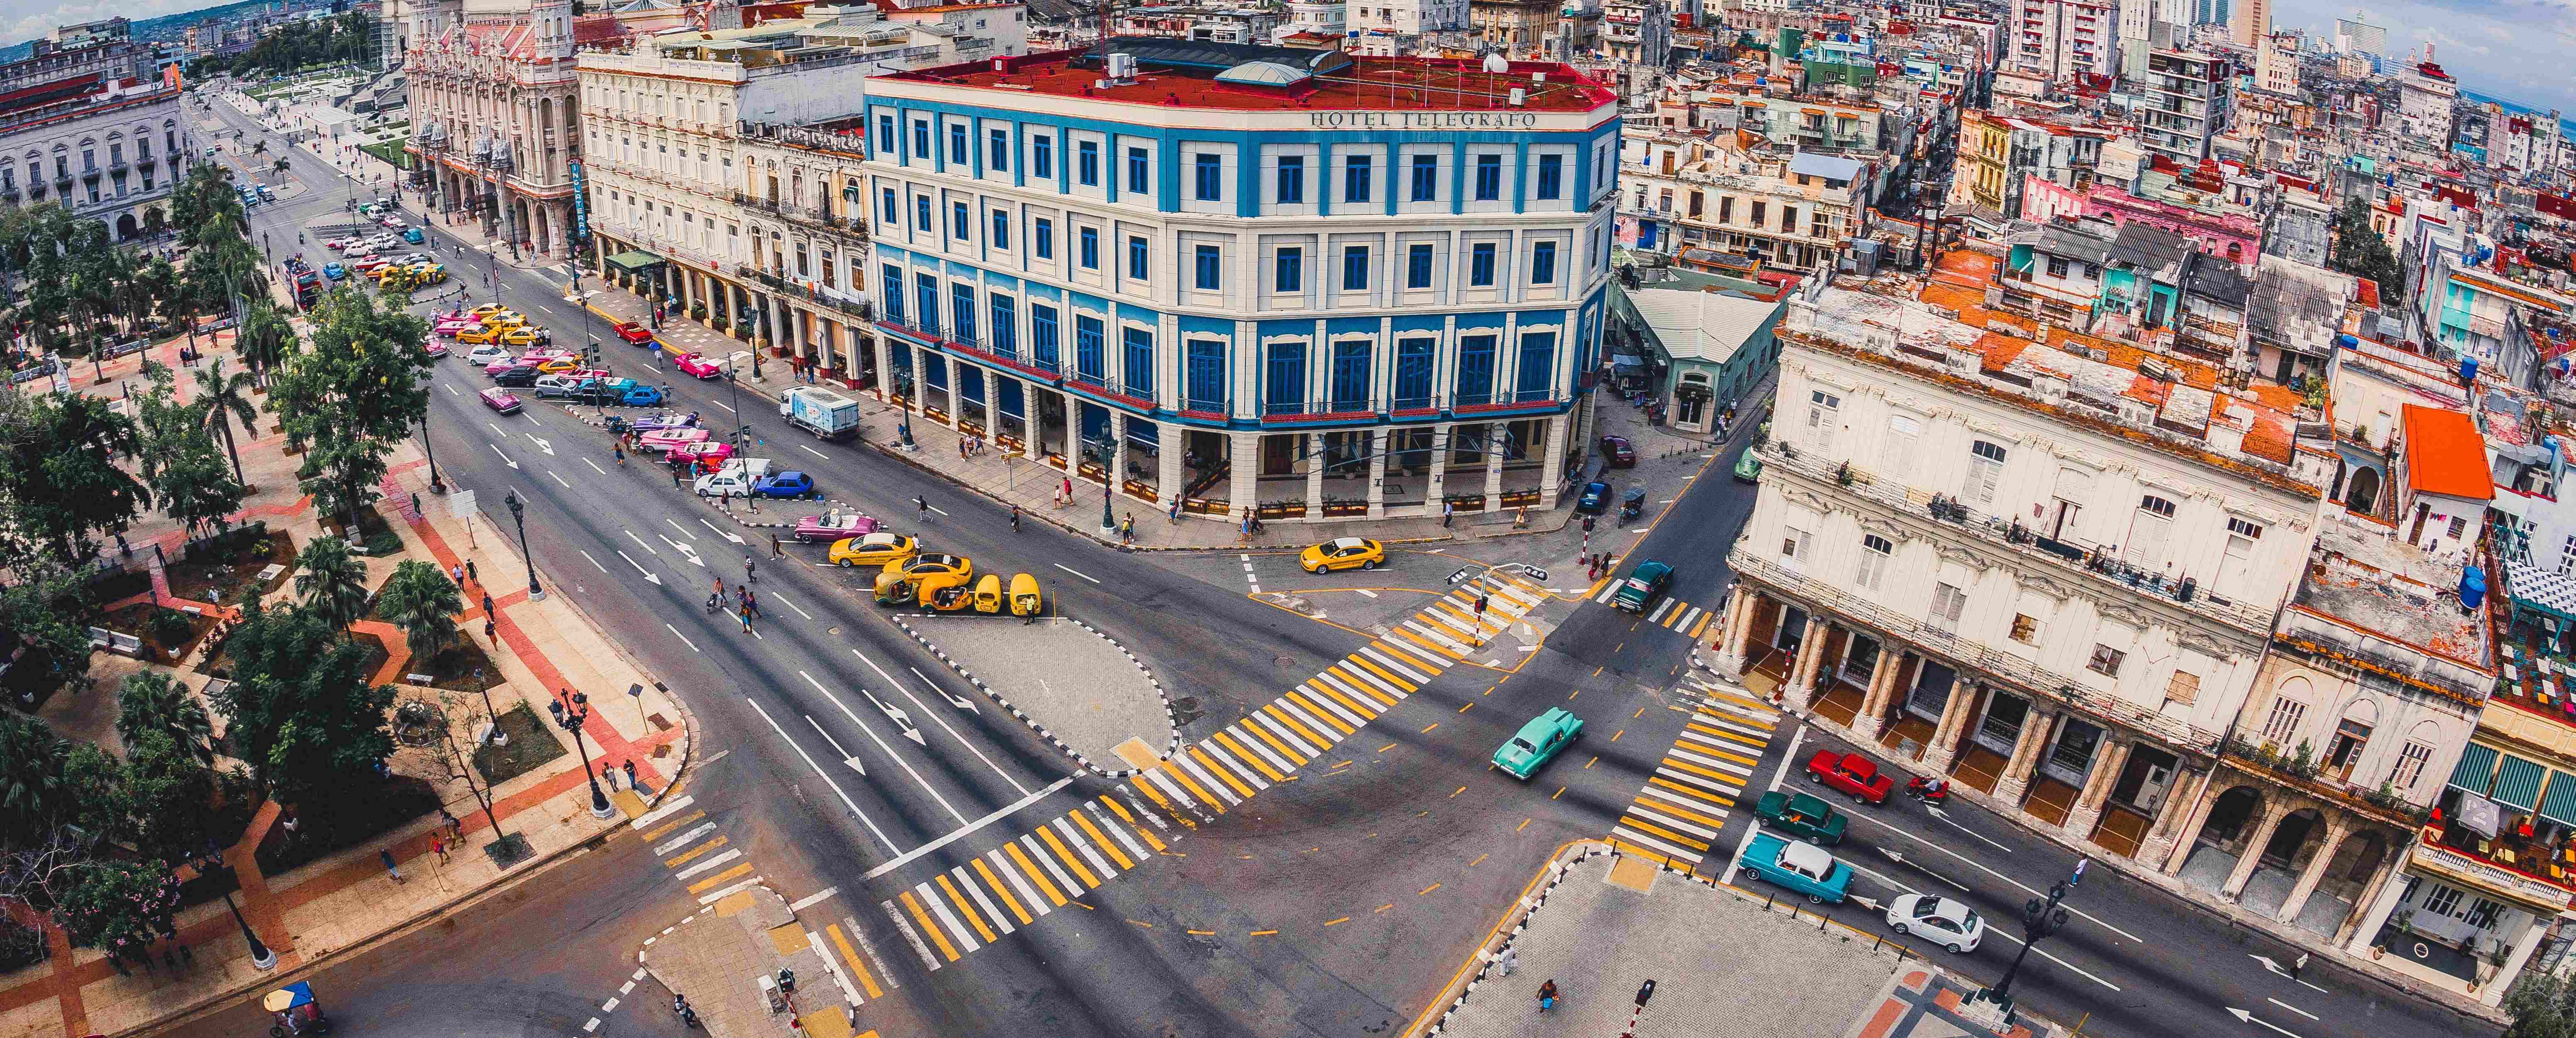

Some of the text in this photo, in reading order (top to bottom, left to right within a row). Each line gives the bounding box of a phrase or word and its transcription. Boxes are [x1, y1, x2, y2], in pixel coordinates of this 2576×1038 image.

[1311, 111, 1535, 126] HOTEL TELEGRAFO
[572, 165, 586, 236] INGLATERRA
